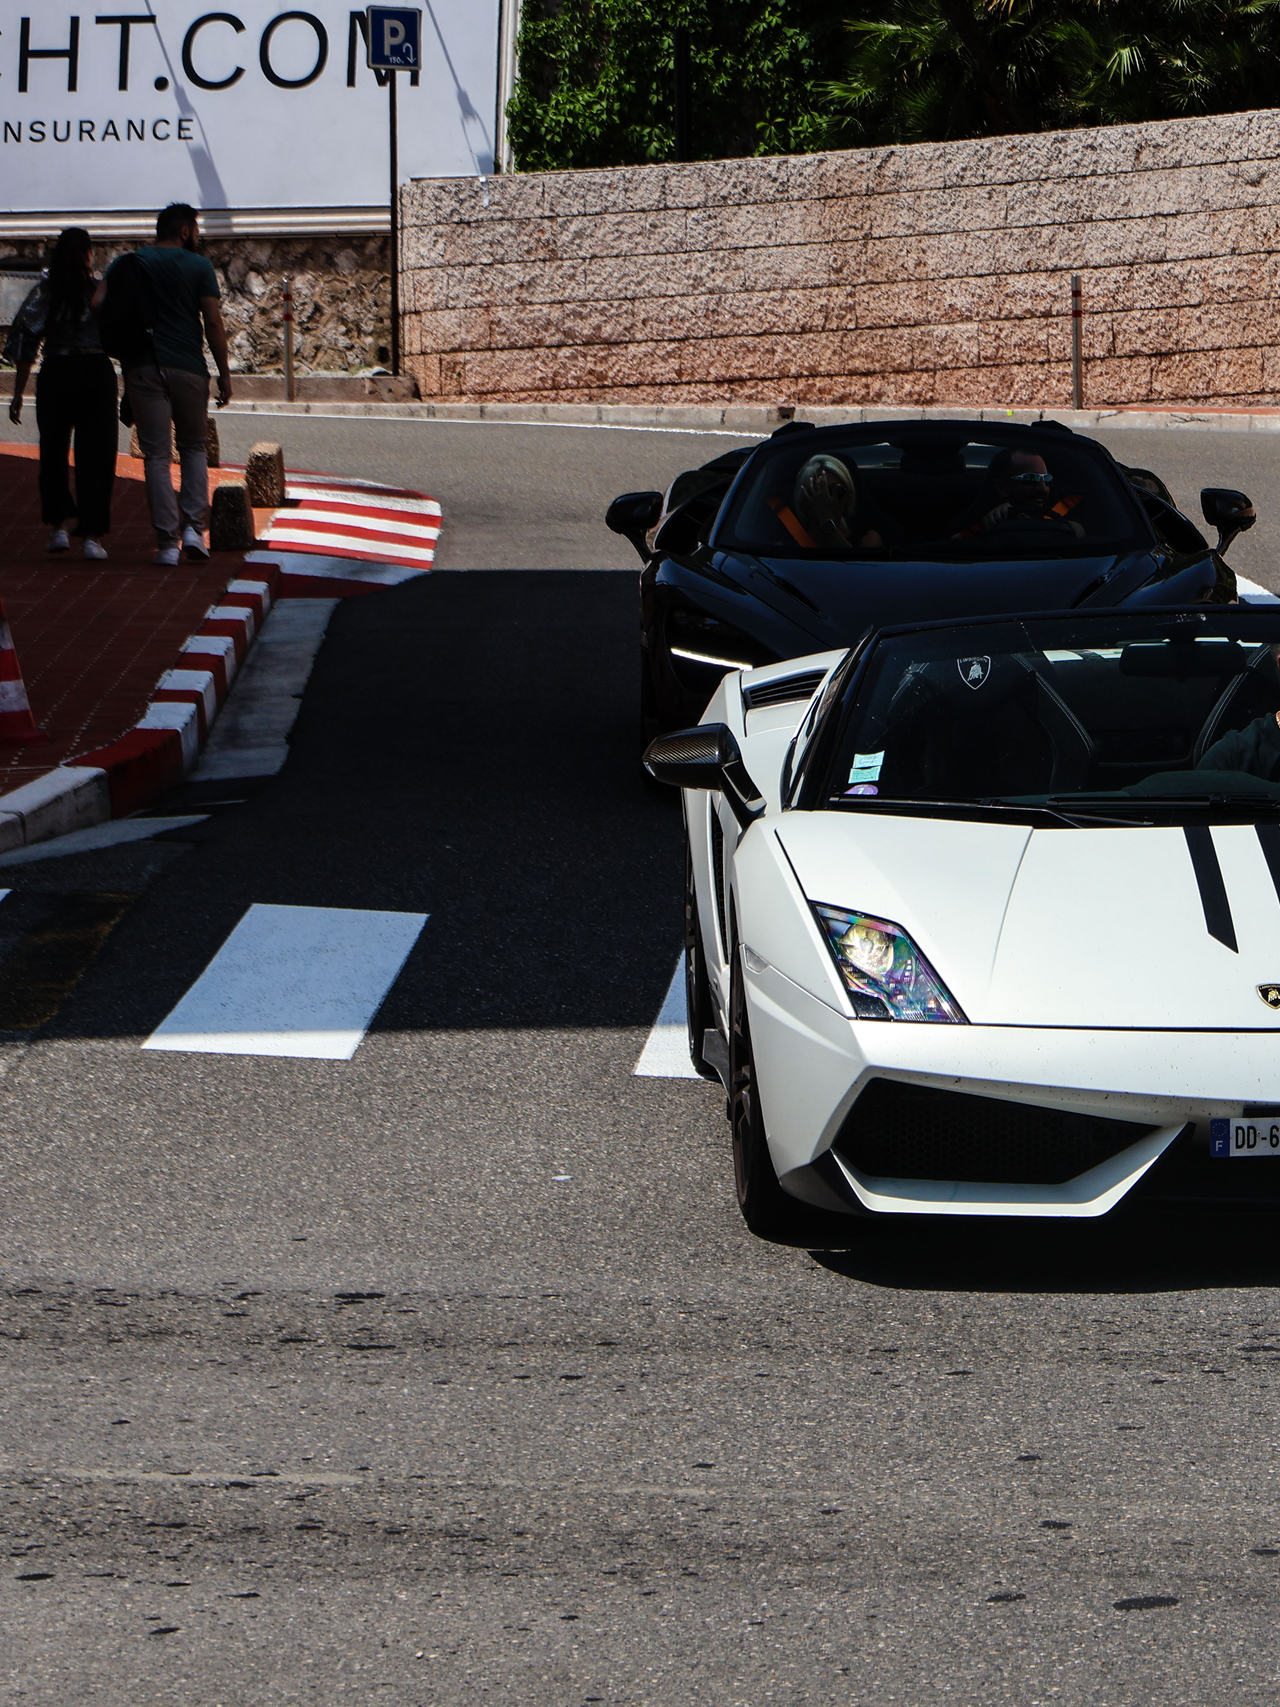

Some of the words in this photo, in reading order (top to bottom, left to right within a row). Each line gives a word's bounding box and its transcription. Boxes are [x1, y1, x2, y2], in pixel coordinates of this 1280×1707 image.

[0, 11, 420, 93] HT.COM
[383, 18, 406, 57] P
[1215, 1140, 1224, 1152] F
